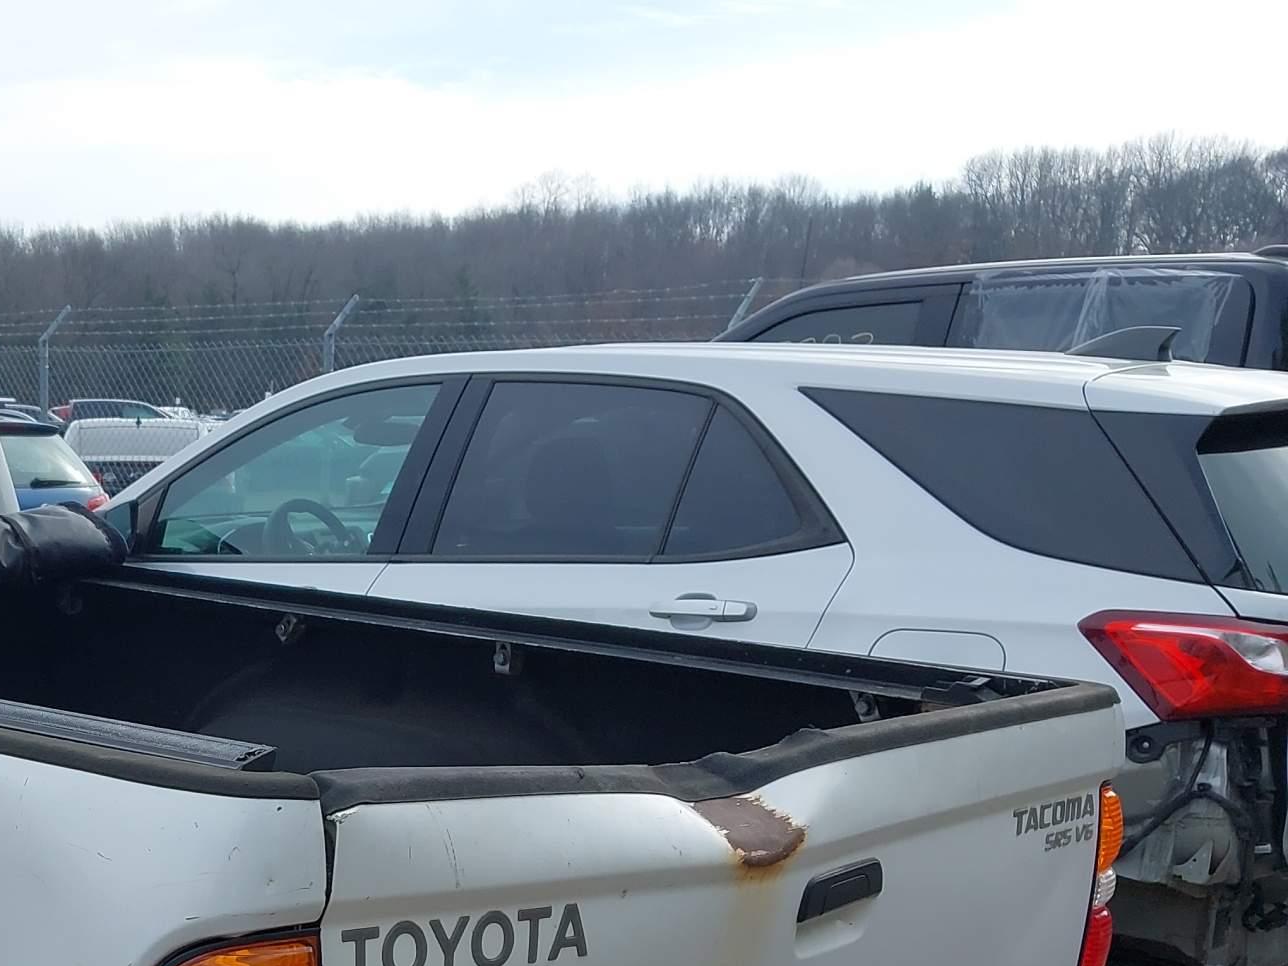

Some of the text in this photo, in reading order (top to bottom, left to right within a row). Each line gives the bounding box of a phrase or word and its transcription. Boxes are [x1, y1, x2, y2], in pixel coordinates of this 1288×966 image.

[1013, 793, 1095, 837] TACOMA
[1044, 822, 1095, 852] SR5 V6
